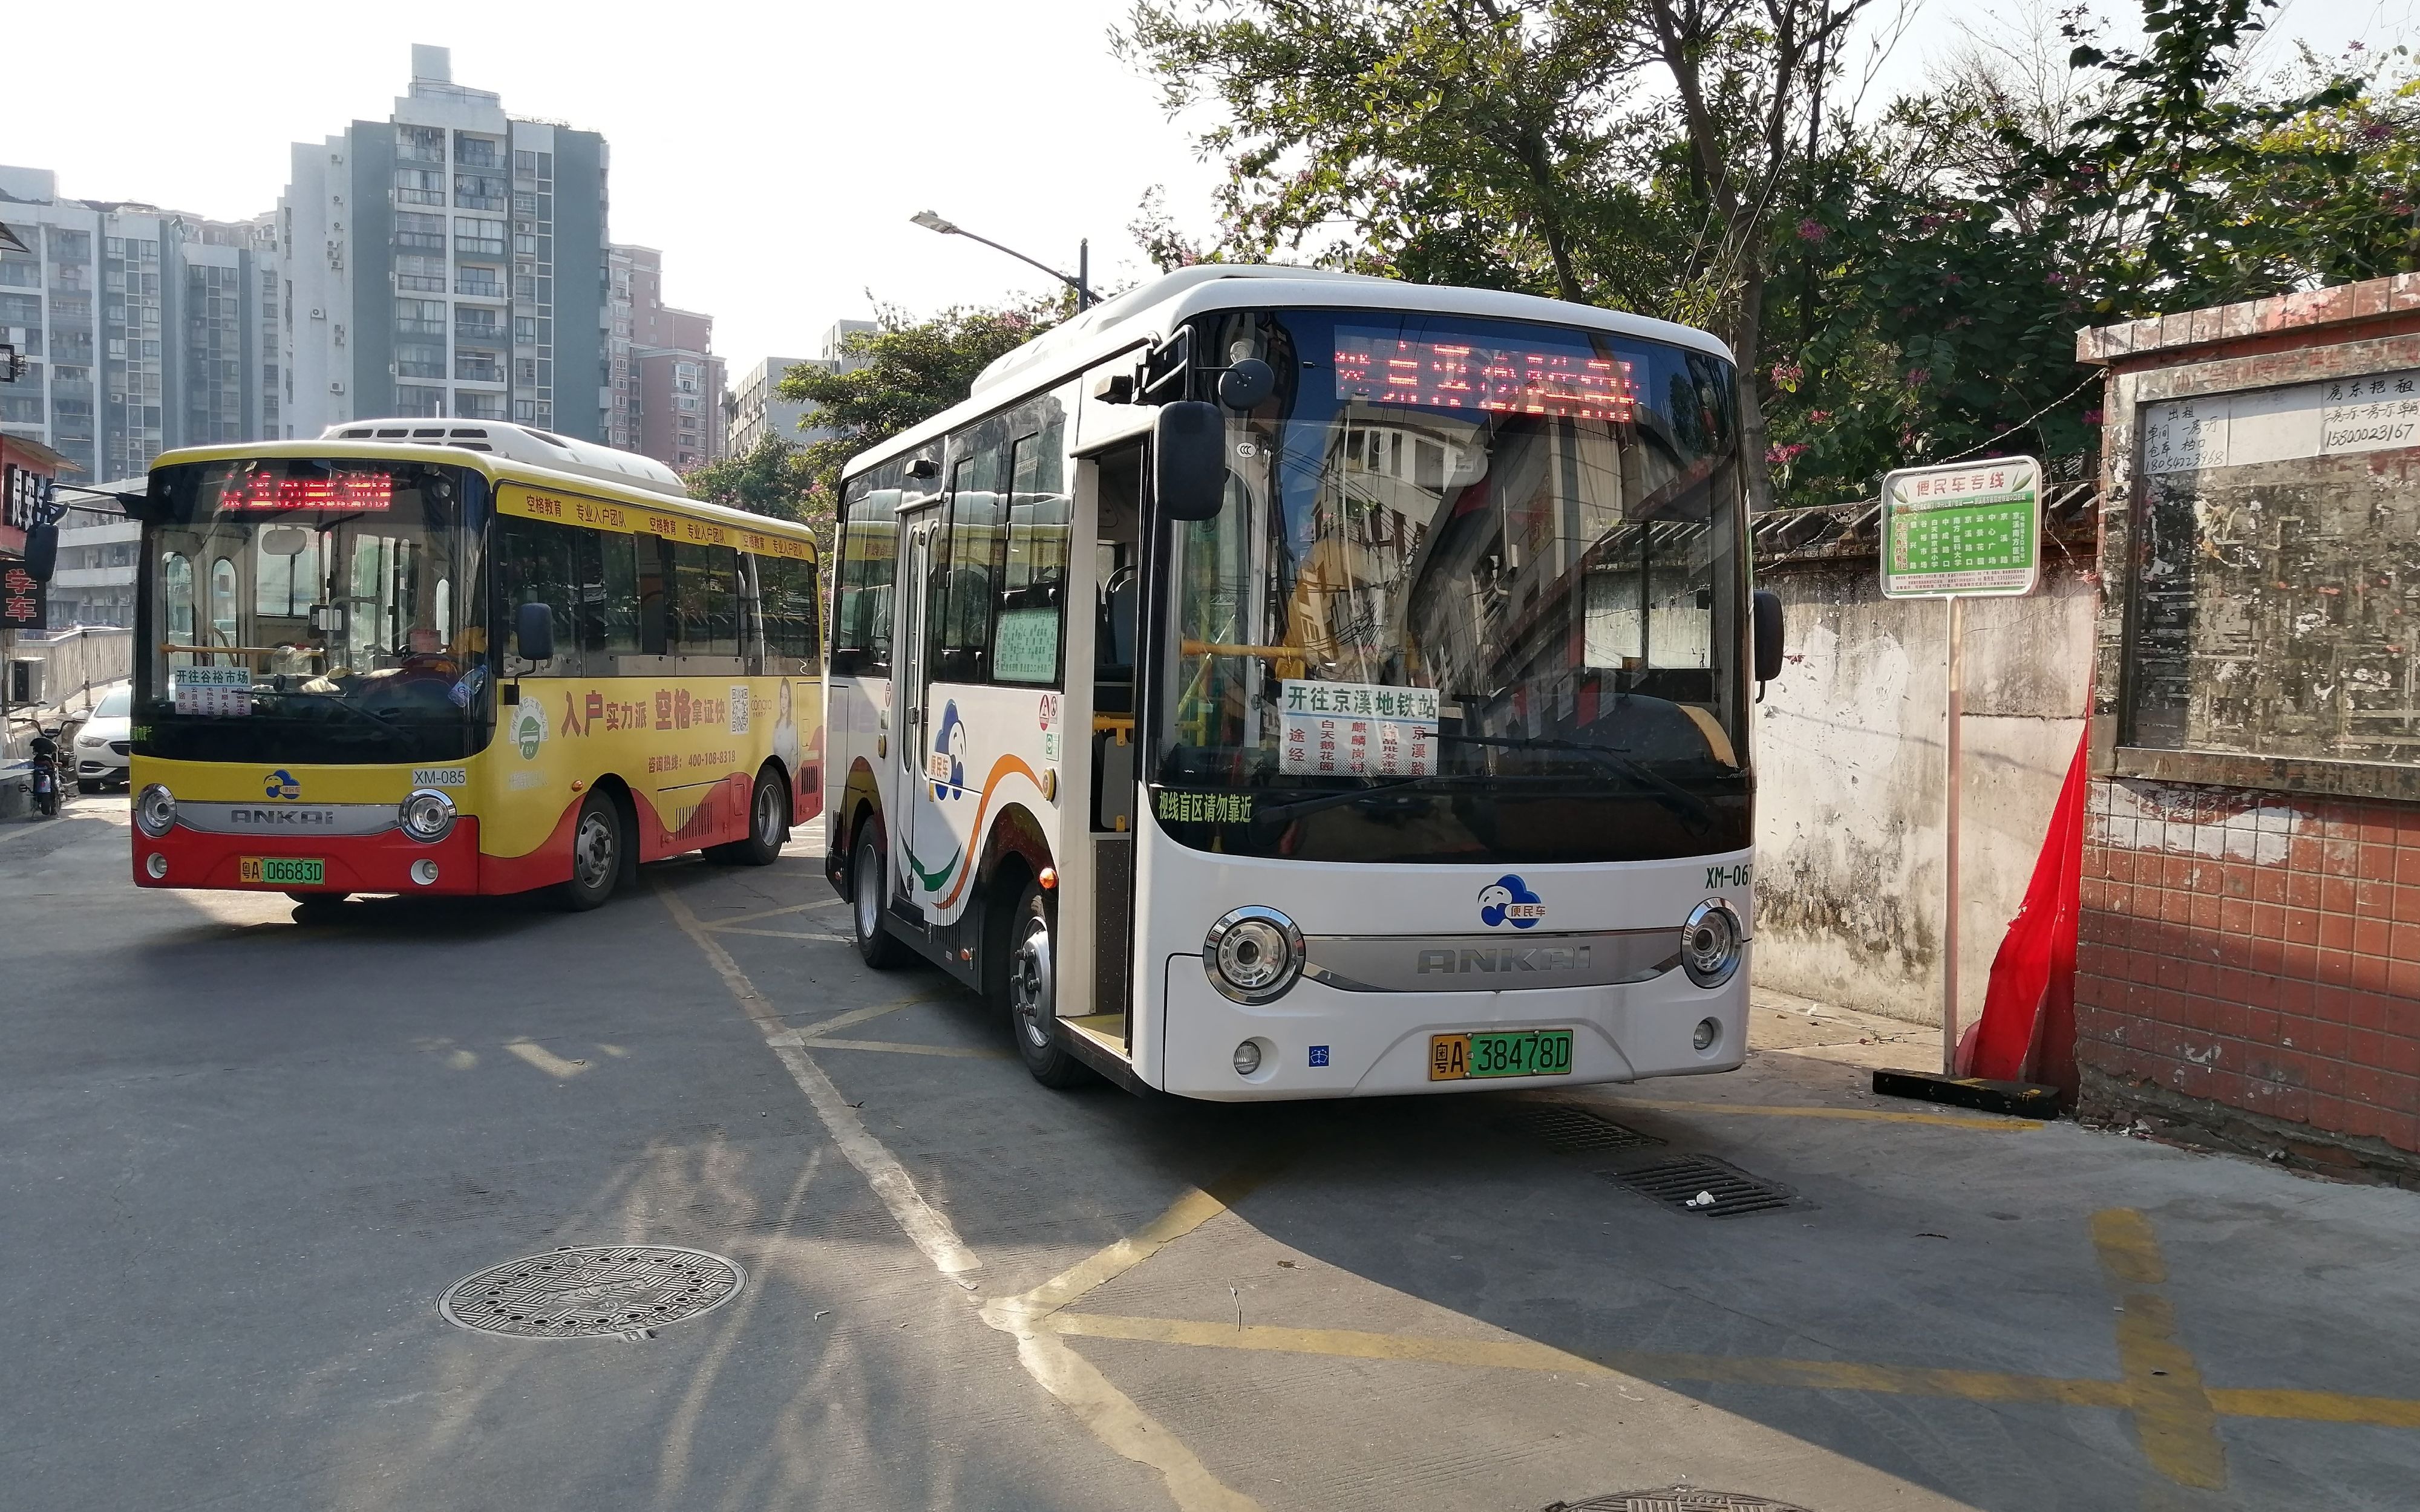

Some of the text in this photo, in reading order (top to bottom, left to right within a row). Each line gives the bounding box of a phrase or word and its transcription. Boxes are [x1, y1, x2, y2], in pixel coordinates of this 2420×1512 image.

[2168, 405, 2194, 421] 出租
[2327, 423, 2415, 448] 15800023167
[2145, 450, 2224, 472] 18054223968
[1917, 472, 2004, 497] 便民车专线
[526, 495, 561, 517] 空格教育
[576, 503, 626, 528] 专业入户团队
[649, 516, 676, 535] 空格教育
[5, 569, 37, 622] 学车
[177, 670, 248, 684] 开往谷裕市场
[1289, 686, 1437, 719] 开往京溪地铁站
[1289, 729, 1305, 761] 途经
[1411, 726, 1426, 775] 京溪路
[414, 770, 466, 785] XM-085
[930, 755, 949, 780] 便民车
[231, 809, 333, 824] ANKAI
[1159, 791, 1252, 823] 视线盲区请勿靠近
[1510, 905, 1546, 917] 便民车
[1418, 946, 1590, 974] ANKAI
